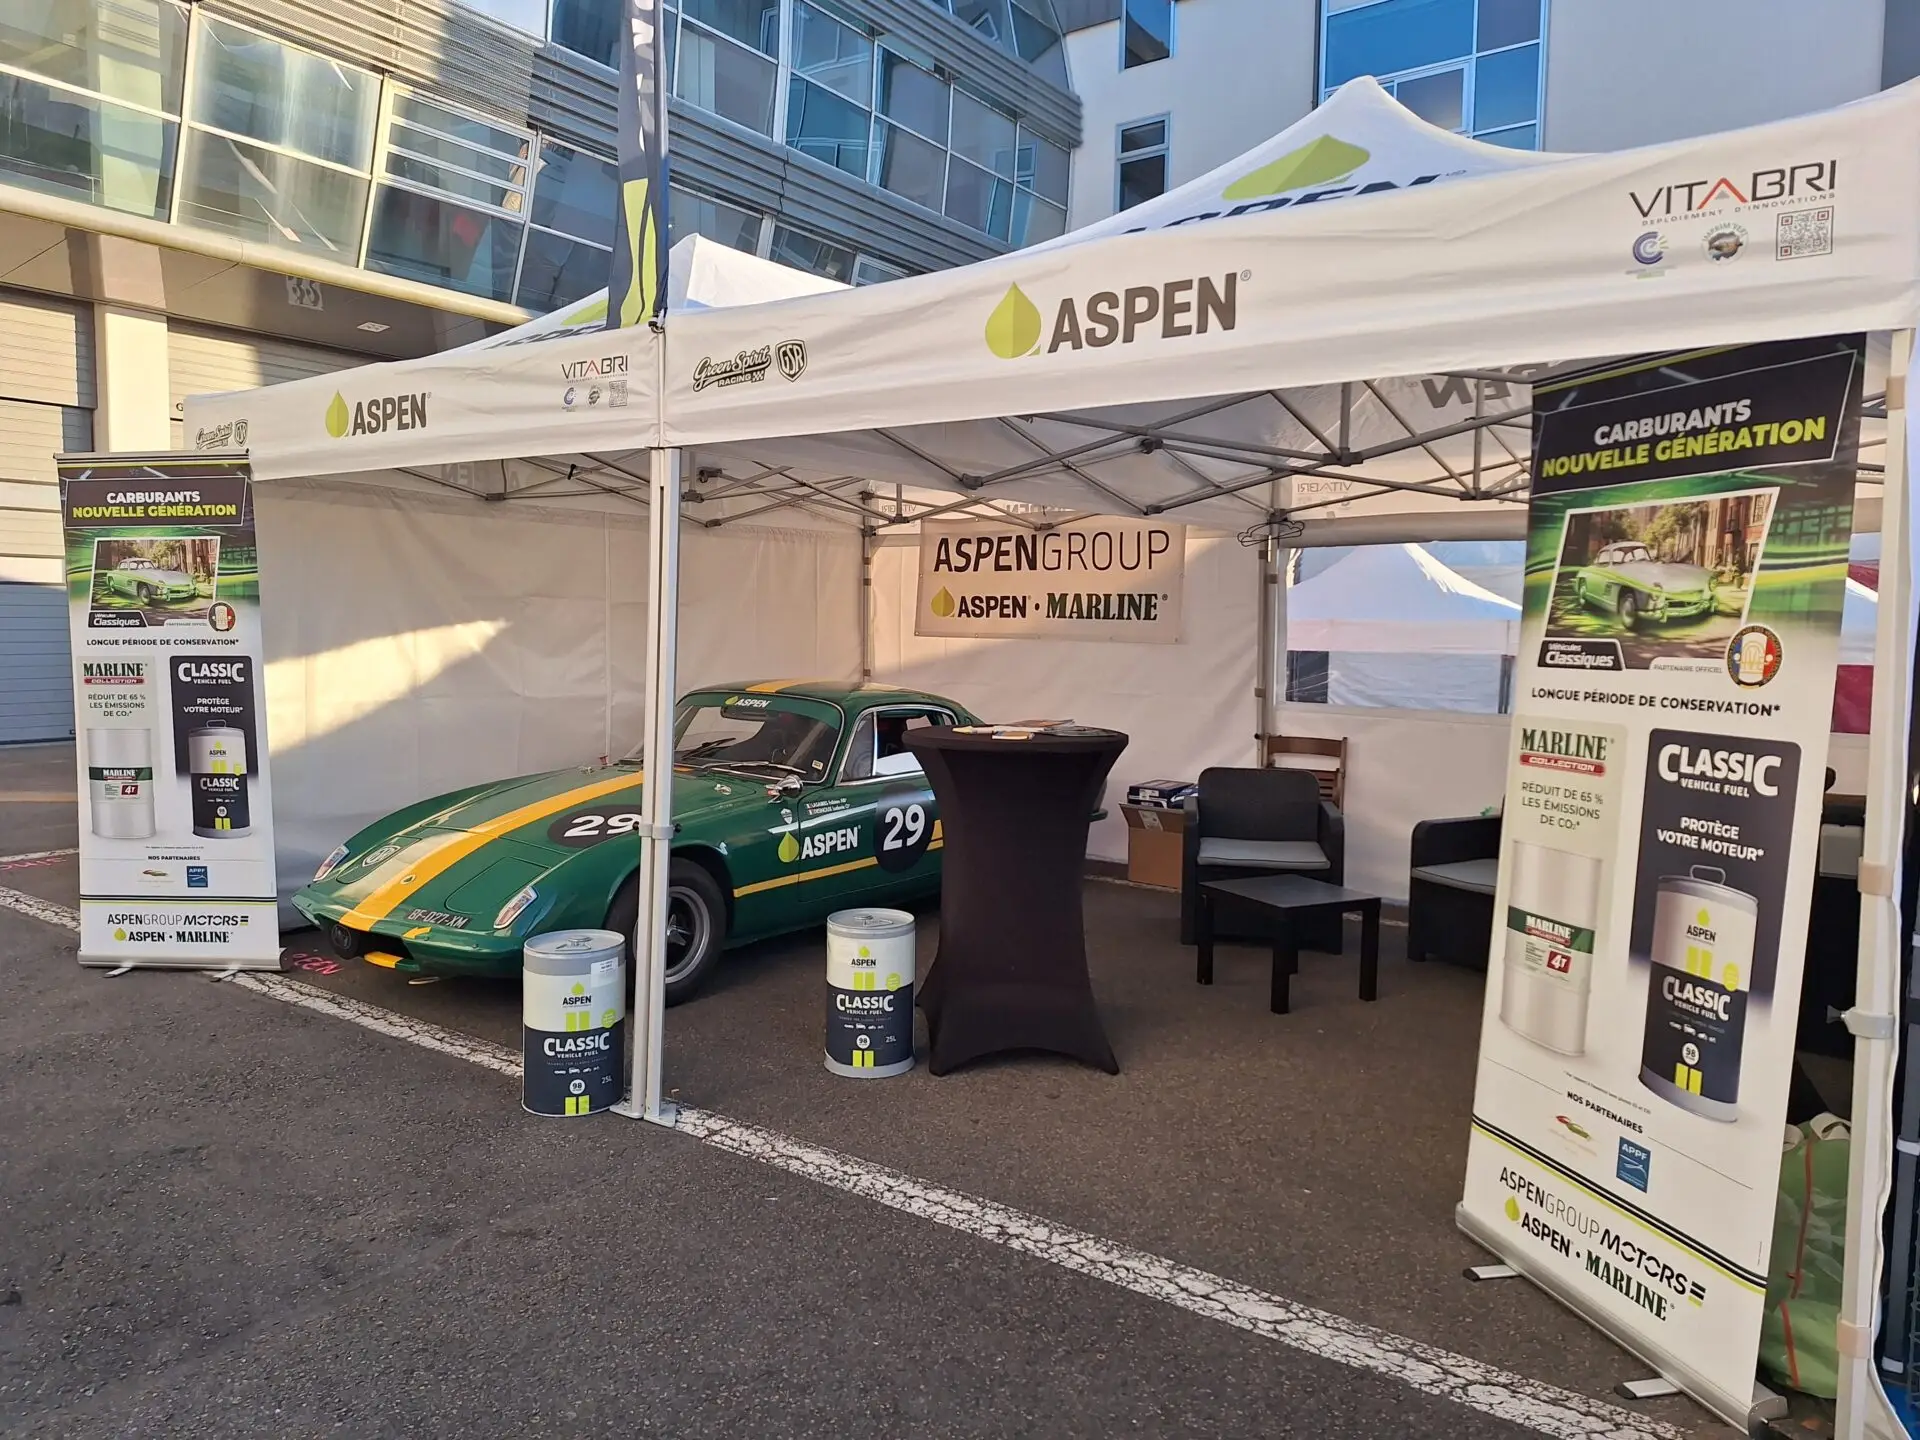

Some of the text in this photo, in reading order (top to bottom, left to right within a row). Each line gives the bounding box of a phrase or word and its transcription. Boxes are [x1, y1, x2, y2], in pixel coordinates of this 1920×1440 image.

[1629, 159, 1838, 218] VITABRI
[1047, 272, 1238, 354] ASPEN
[561, 355, 628, 379] VITABRI
[693, 345, 771, 391] Green Spirit
[717, 374, 752, 387] RACING
[351, 392, 427, 436] ASPEN
[1593, 399, 1752, 446] CARBURANTS
[1542, 416, 1826, 478] NOUVELLE GÉNÉRATION
[106, 491, 201, 504] CARBURANTS
[72, 502, 237, 518] NOUVELLE GÉNÉRATION
[933, 529, 1170, 573] ASPENGROUP
[957, 592, 1159, 621] ASPEN MARLINE
[93, 617, 140, 628] Classiques
[122, 637, 158, 646] PÉRIODE
[1547, 643, 1582, 652] Véhicules
[1544, 650, 1615, 669] Classiques
[83, 662, 144, 677] MARLINE
[177, 662, 245, 683] CLASSIC
[104, 701, 145, 709] ÉMISSIONS
[196, 697, 230, 705] PROTÈGE
[734, 698, 770, 708] ASPEN
[1531, 688, 1581, 702] LONGUE
[1583, 688, 1636, 706] PÉRIODE
[1638, 695, 1656, 708] DE
[183, 706, 209, 714] VOTRE
[1520, 728, 1608, 761] MARLINE
[1528, 756, 1596, 772] COLLECTION
[1657, 743, 1782, 796] CLASSIC
[200, 777, 240, 791] CLASSIC
[1521, 781, 1604, 805] RÉDUIT DE 65 %
[1680, 777, 1750, 798] VEHICLE FUEL
[1521, 797, 1601, 820] LES ÉMISSIONS
[563, 814, 642, 838] 29
[883, 803, 926, 851] 29
[1540, 814, 1555, 826] DE
[1679, 816, 1740, 840] PROTÈGE
[800, 826, 858, 860] ASPEN
[1656, 828, 1699, 849] VOTRE
[107, 914, 239, 926] ASPENGROUP MOTORS
[1525, 914, 1572, 940] MARLINE
[128, 931, 230, 943] ASPEN MARLINE
[1686, 924, 1716, 943] ASPEN
[851, 958, 877, 967] ASPEN
[562, 995, 592, 1006] ASPEN
[836, 993, 894, 1012] CLASSIC
[1662, 975, 1731, 1022] CLASSIC
[1701, 1008, 1717, 1021] FUEL
[543, 1032, 610, 1057] CLASSIC
[1685, 1046, 1697, 1059] 98
[556, 1050, 599, 1060] VEHICLE FUEL
[571, 1081, 583, 1090] 98
[601, 1074, 613, 1085] 25L
[1567, 1090, 1584, 1105] NOS
[1585, 1100, 1644, 1134] PARTENAIRES
[1621, 1143, 1648, 1161] APPF
[1499, 1166, 1689, 1296] ASPENGROUP MOTORS
[1521, 1212, 1668, 1322] ASPEN MARLINE
